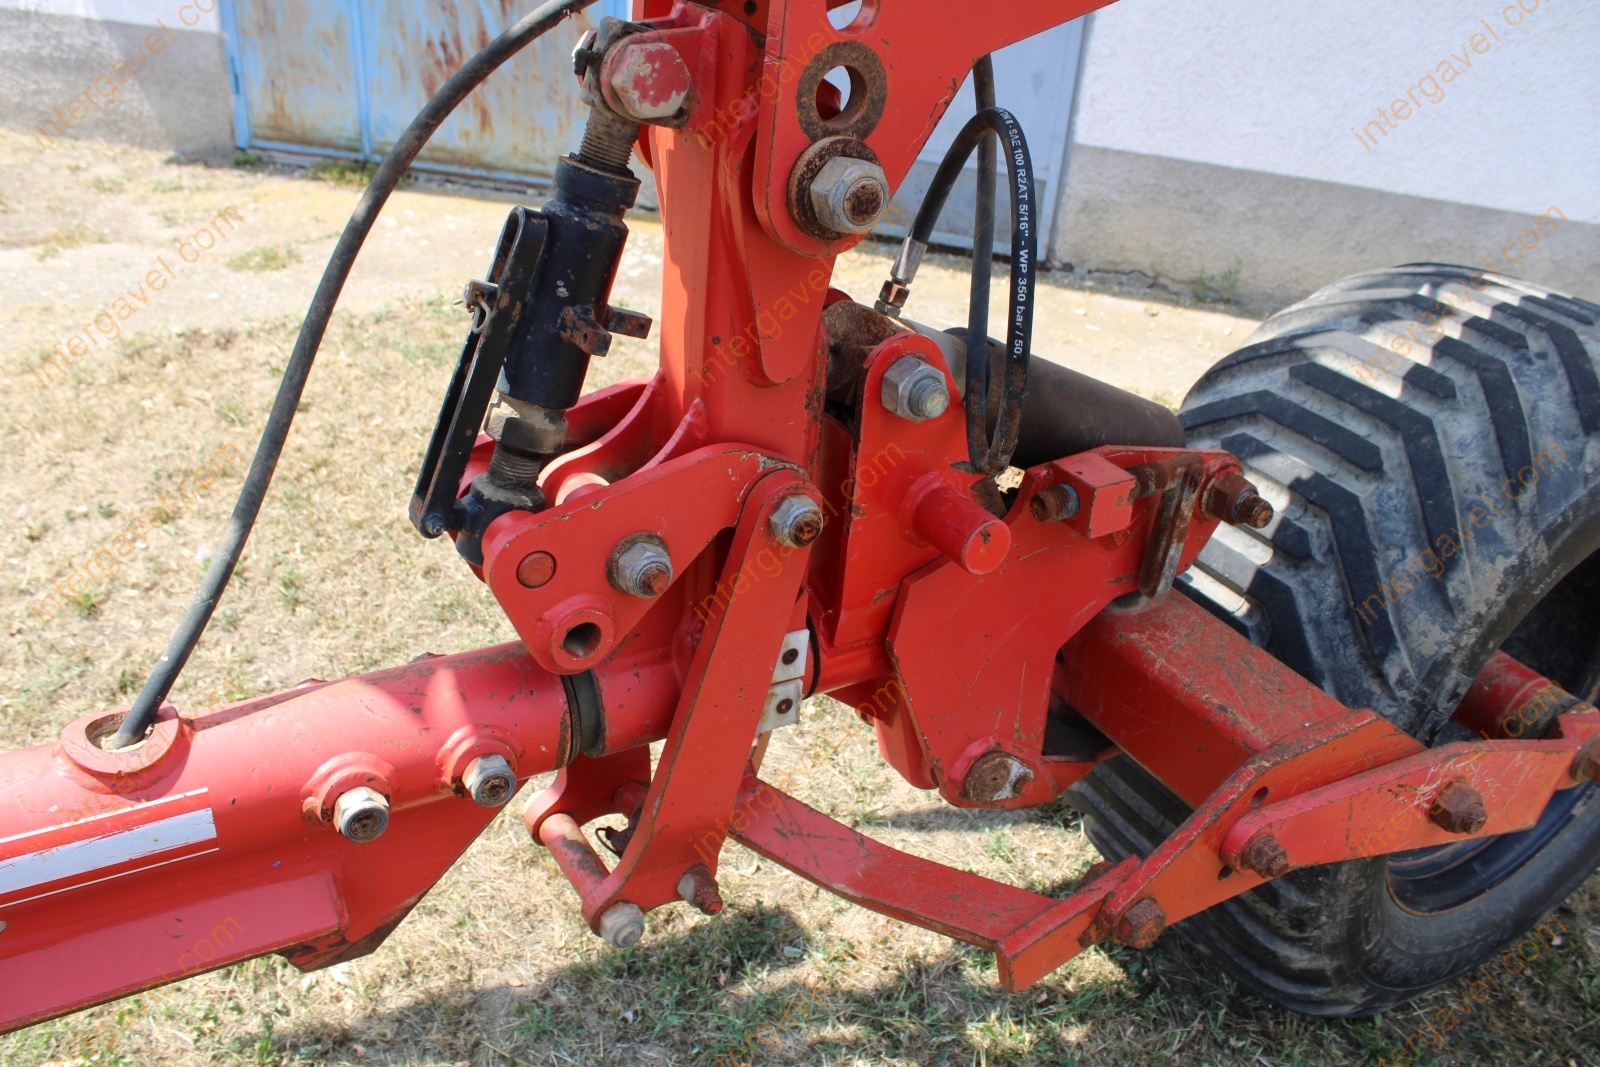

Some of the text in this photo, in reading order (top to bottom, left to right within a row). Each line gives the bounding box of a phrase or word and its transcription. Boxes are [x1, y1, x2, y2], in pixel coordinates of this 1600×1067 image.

[1008, 128, 1021, 148] SAE
[1013, 148, 1025, 167] 100
[1016, 168, 1029, 201] R2AT
[1018, 203, 1029, 237] 5/16"
[1019, 249, 1029, 274] WP
[1016, 277, 1027, 302] 350
[1015, 305, 1026, 329] bar
